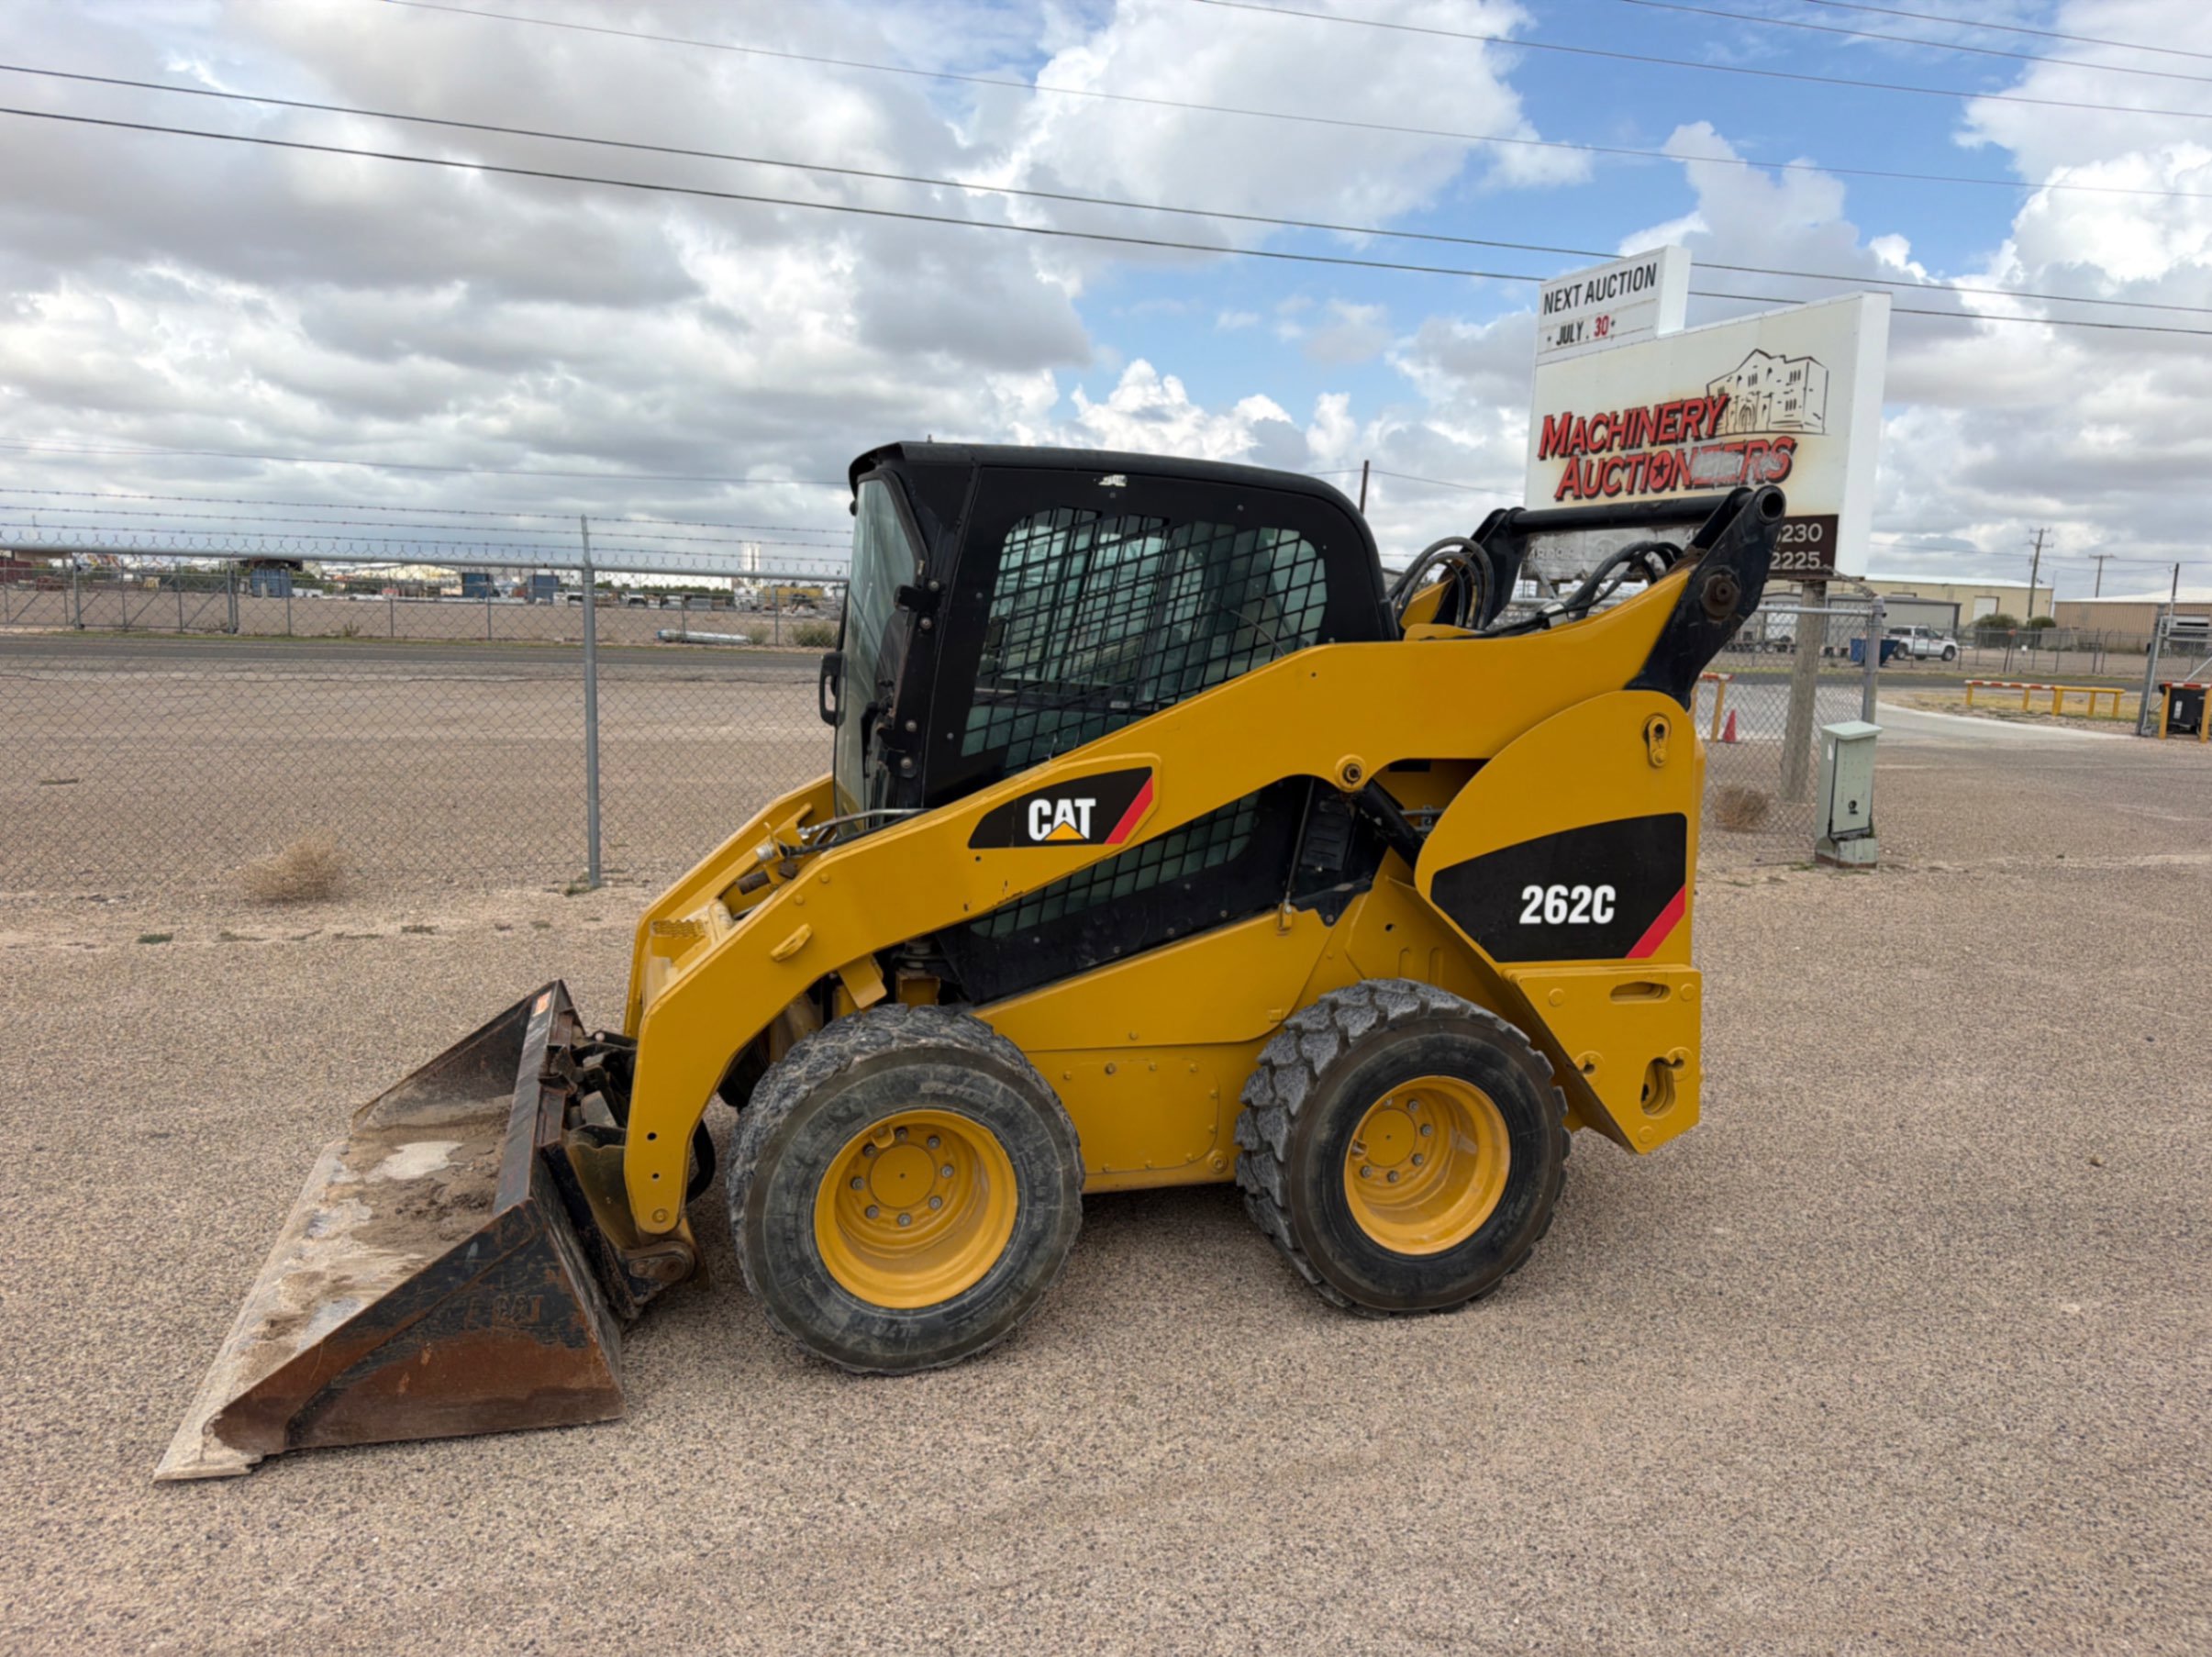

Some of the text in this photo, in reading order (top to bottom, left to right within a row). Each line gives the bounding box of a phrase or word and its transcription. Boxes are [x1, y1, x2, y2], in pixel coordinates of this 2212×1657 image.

[1543, 262, 1657, 315] NEXT AUCTION
[1594, 315, 1609, 338] 30
[1539, 393, 1728, 461] MACHINERY
[1776, 523, 1823, 542] 230
[1028, 798, 1096, 841] CAT
[1519, 884, 1616, 925] 262C
